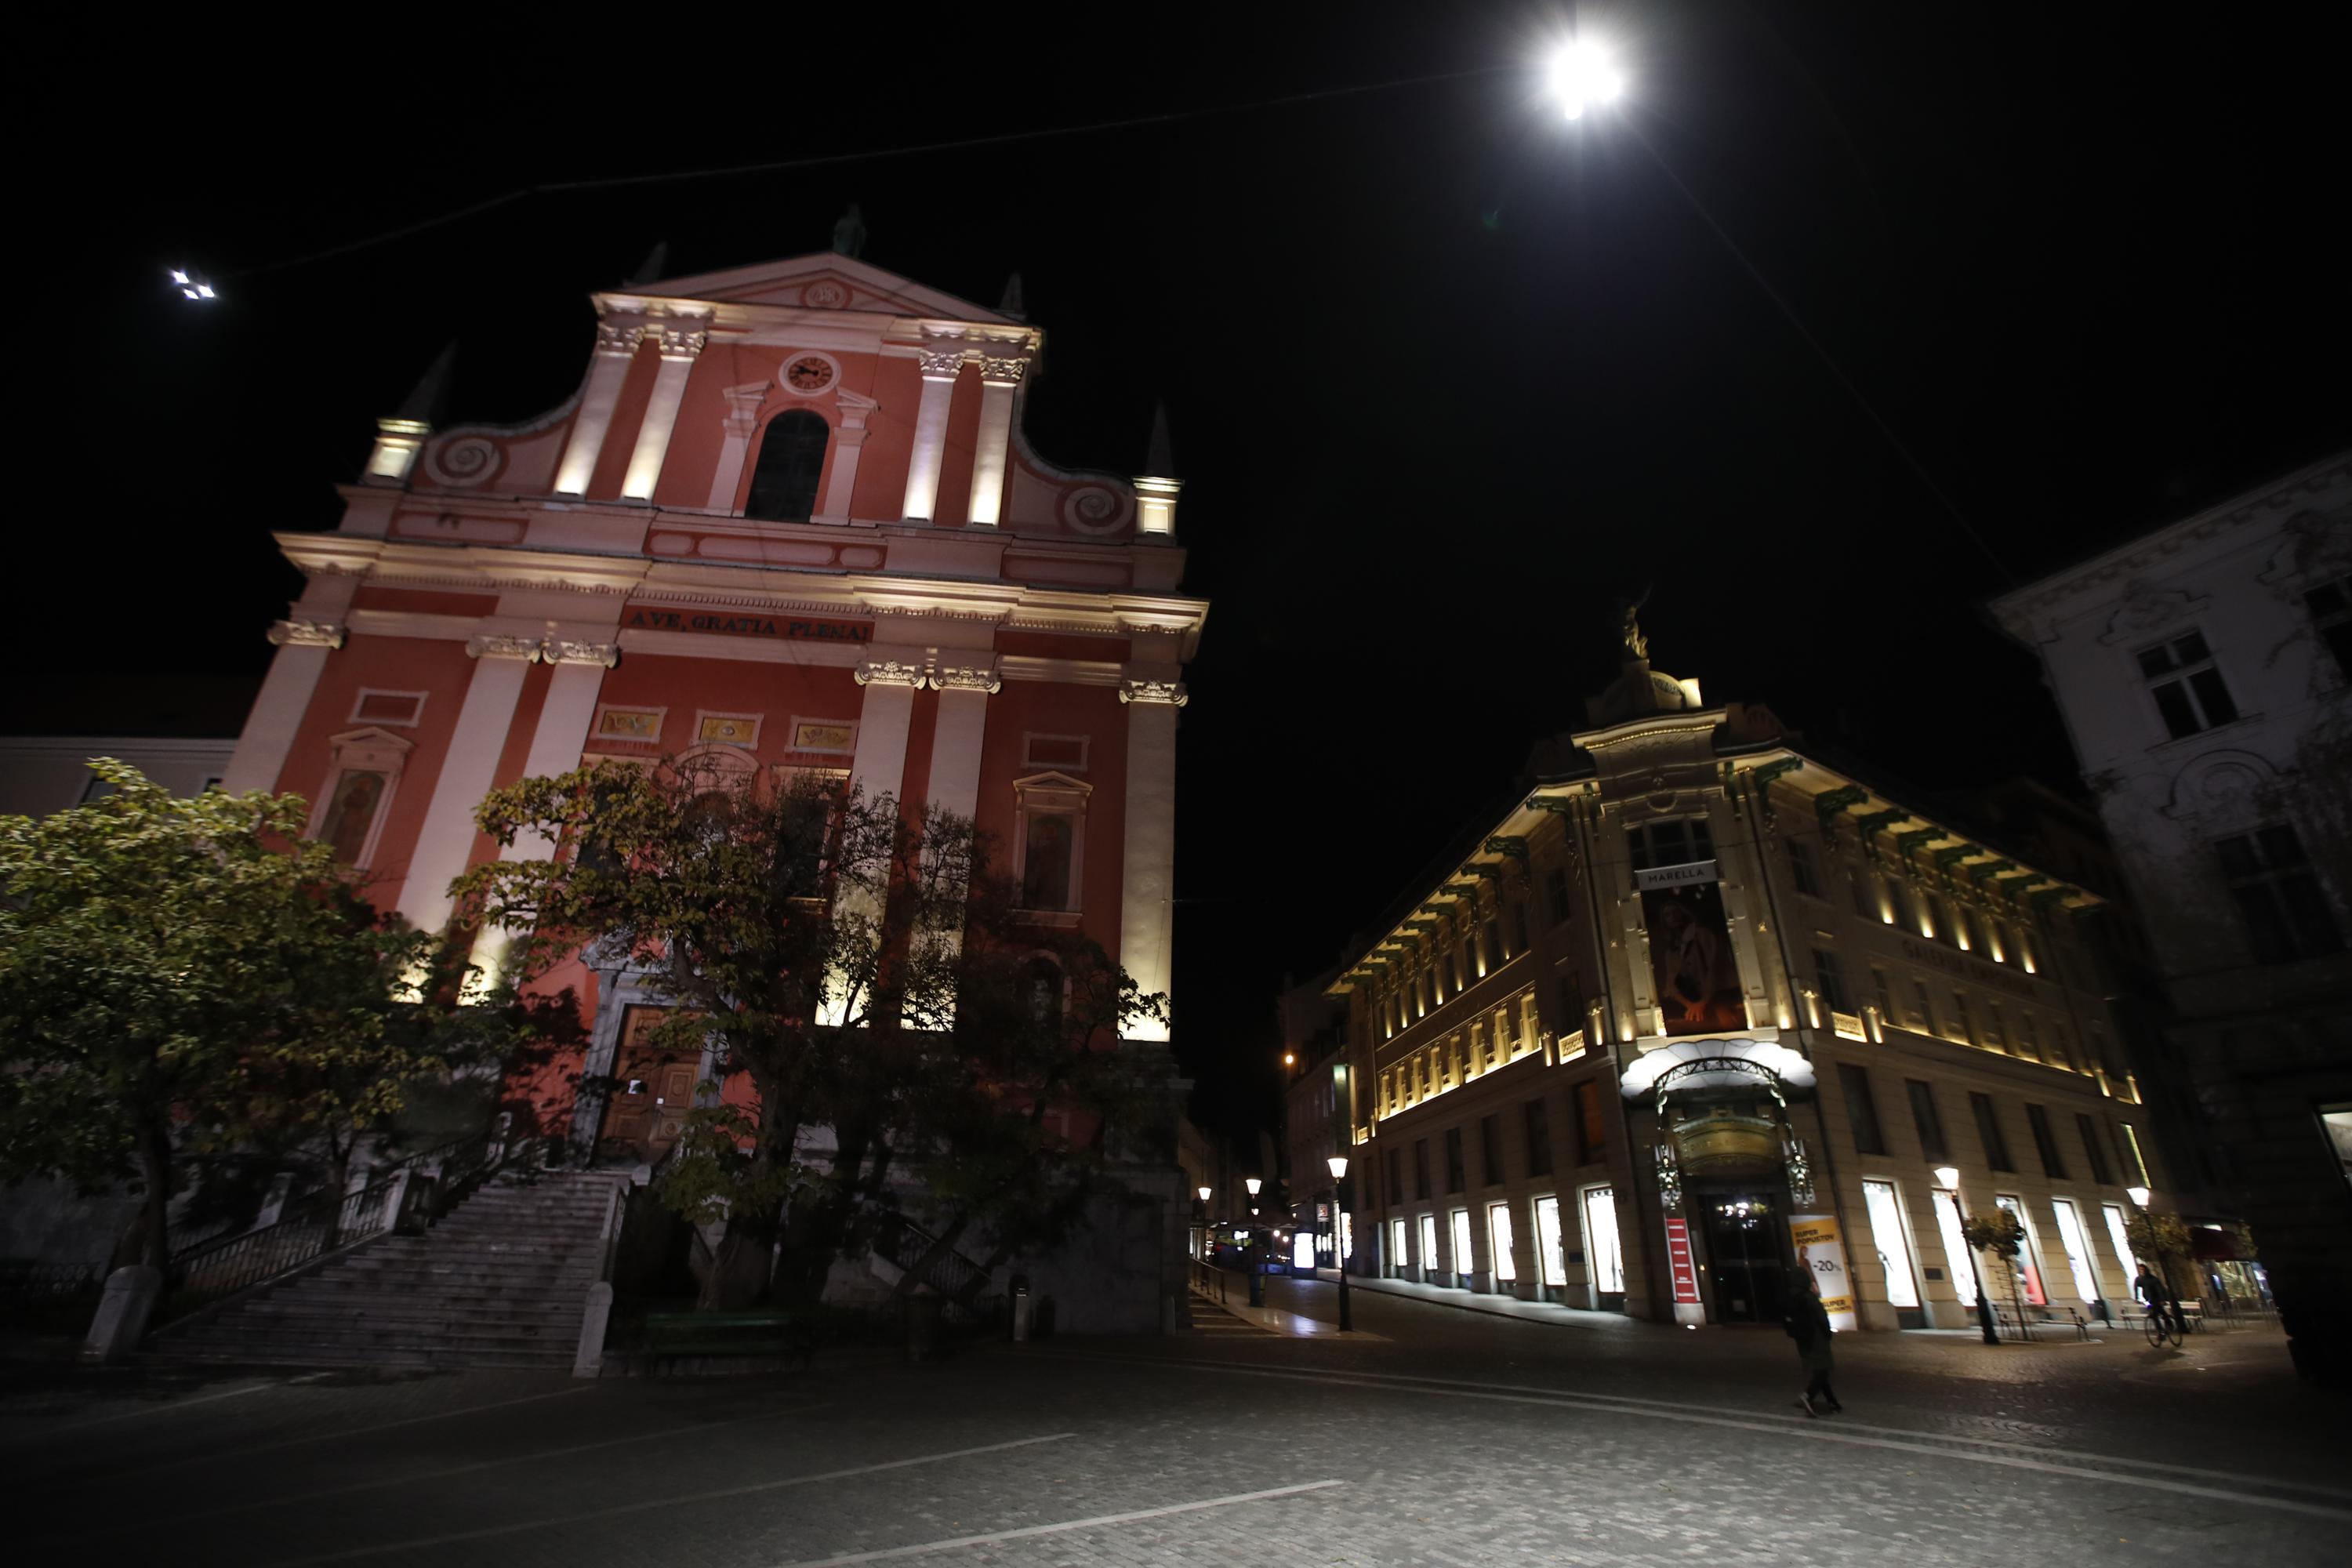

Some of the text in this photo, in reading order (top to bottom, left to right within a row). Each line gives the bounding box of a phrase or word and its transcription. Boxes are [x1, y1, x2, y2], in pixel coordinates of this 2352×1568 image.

[630, 612, 869, 641] AVE, GRATIA PLENA!
[1648, 868, 1704, 883] MARELLA
